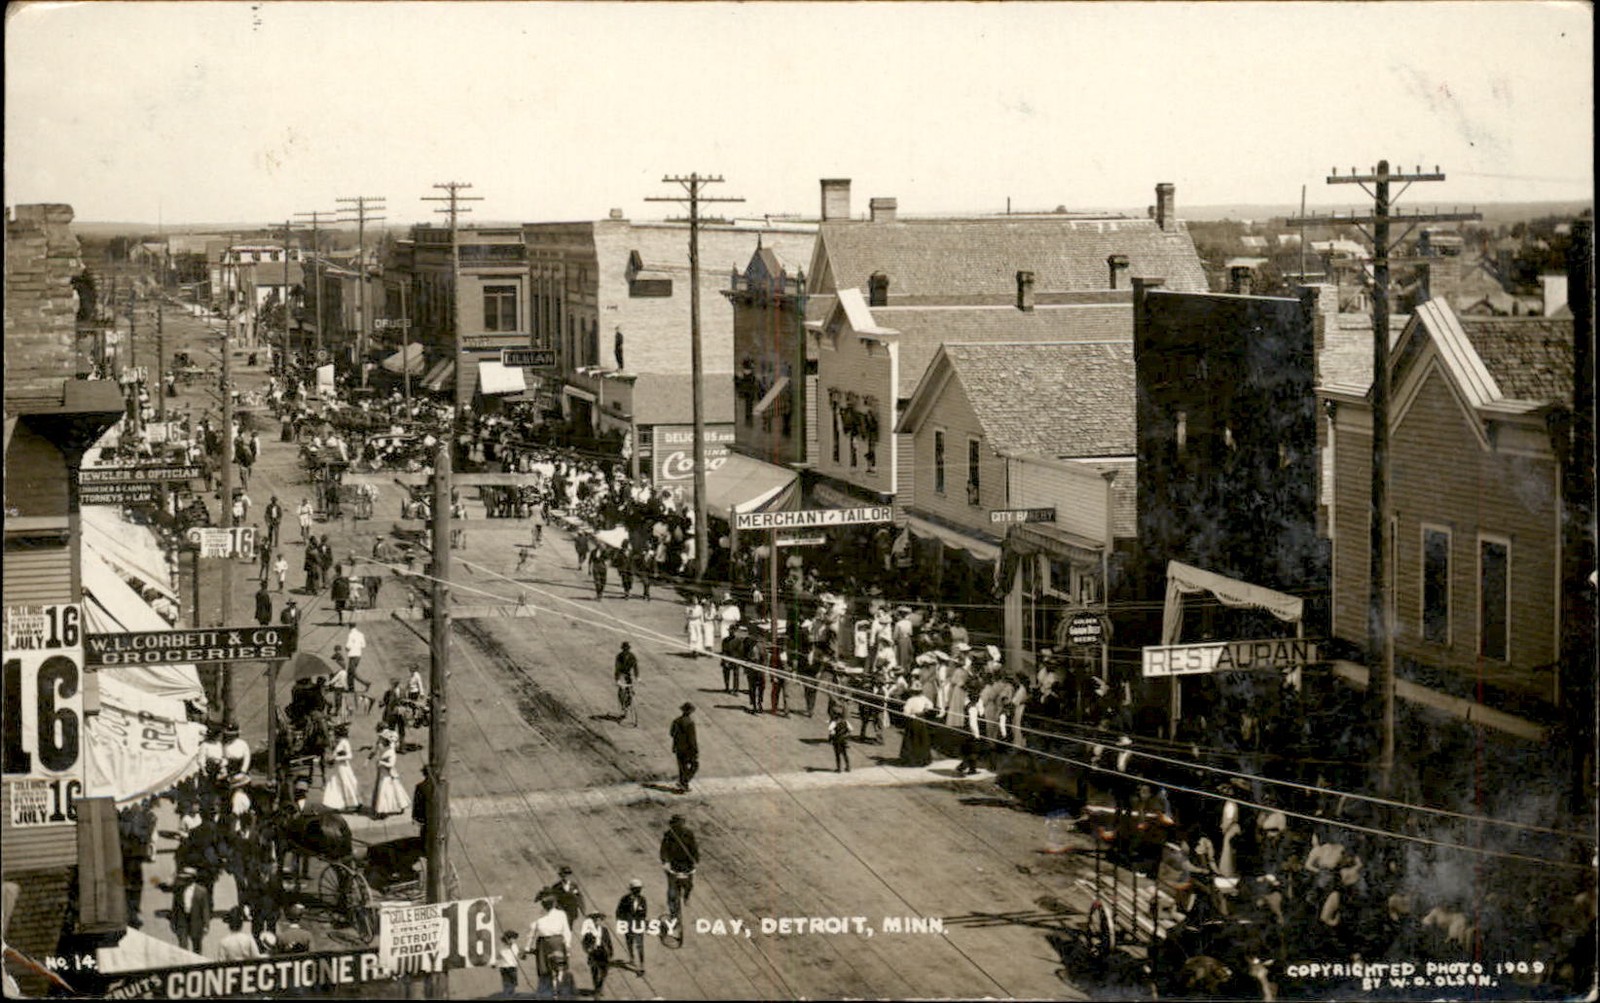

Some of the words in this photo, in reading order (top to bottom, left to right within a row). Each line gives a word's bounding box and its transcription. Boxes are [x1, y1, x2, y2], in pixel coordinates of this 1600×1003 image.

[665, 431, 718, 443] DELICUS
[135, 469, 145, 479] &
[148, 467, 199, 478] OPTICIAN
[662, 451, 728, 479] Coa
[80, 493, 123, 504] TTORNEYS
[133, 492, 152, 501] LAW
[738, 511, 826, 527] MERCHANT
[840, 507, 890, 522] TAILOR
[991, 511, 1012, 522] CITY
[229, 528, 252, 559] 16
[46, 605, 79, 648] 16
[11, 635, 43, 650] JULY
[132, 632, 219, 650] CORBETT
[229, 631, 242, 645] &
[253, 630, 283, 646] CO.
[102, 646, 277, 665] GROCERIES
[3, 655, 79, 774] 16
[50, 780, 82, 822] 16
[15, 810, 47, 824] JULY
[390, 908, 412, 924] COLE
[393, 931, 438, 946] DETROIT
[442, 900, 492, 972] 16
[391, 941, 438, 957] FRIDAY
[391, 951, 439, 977] JULY
[167, 952, 391, 1000] CONFECTIONER
